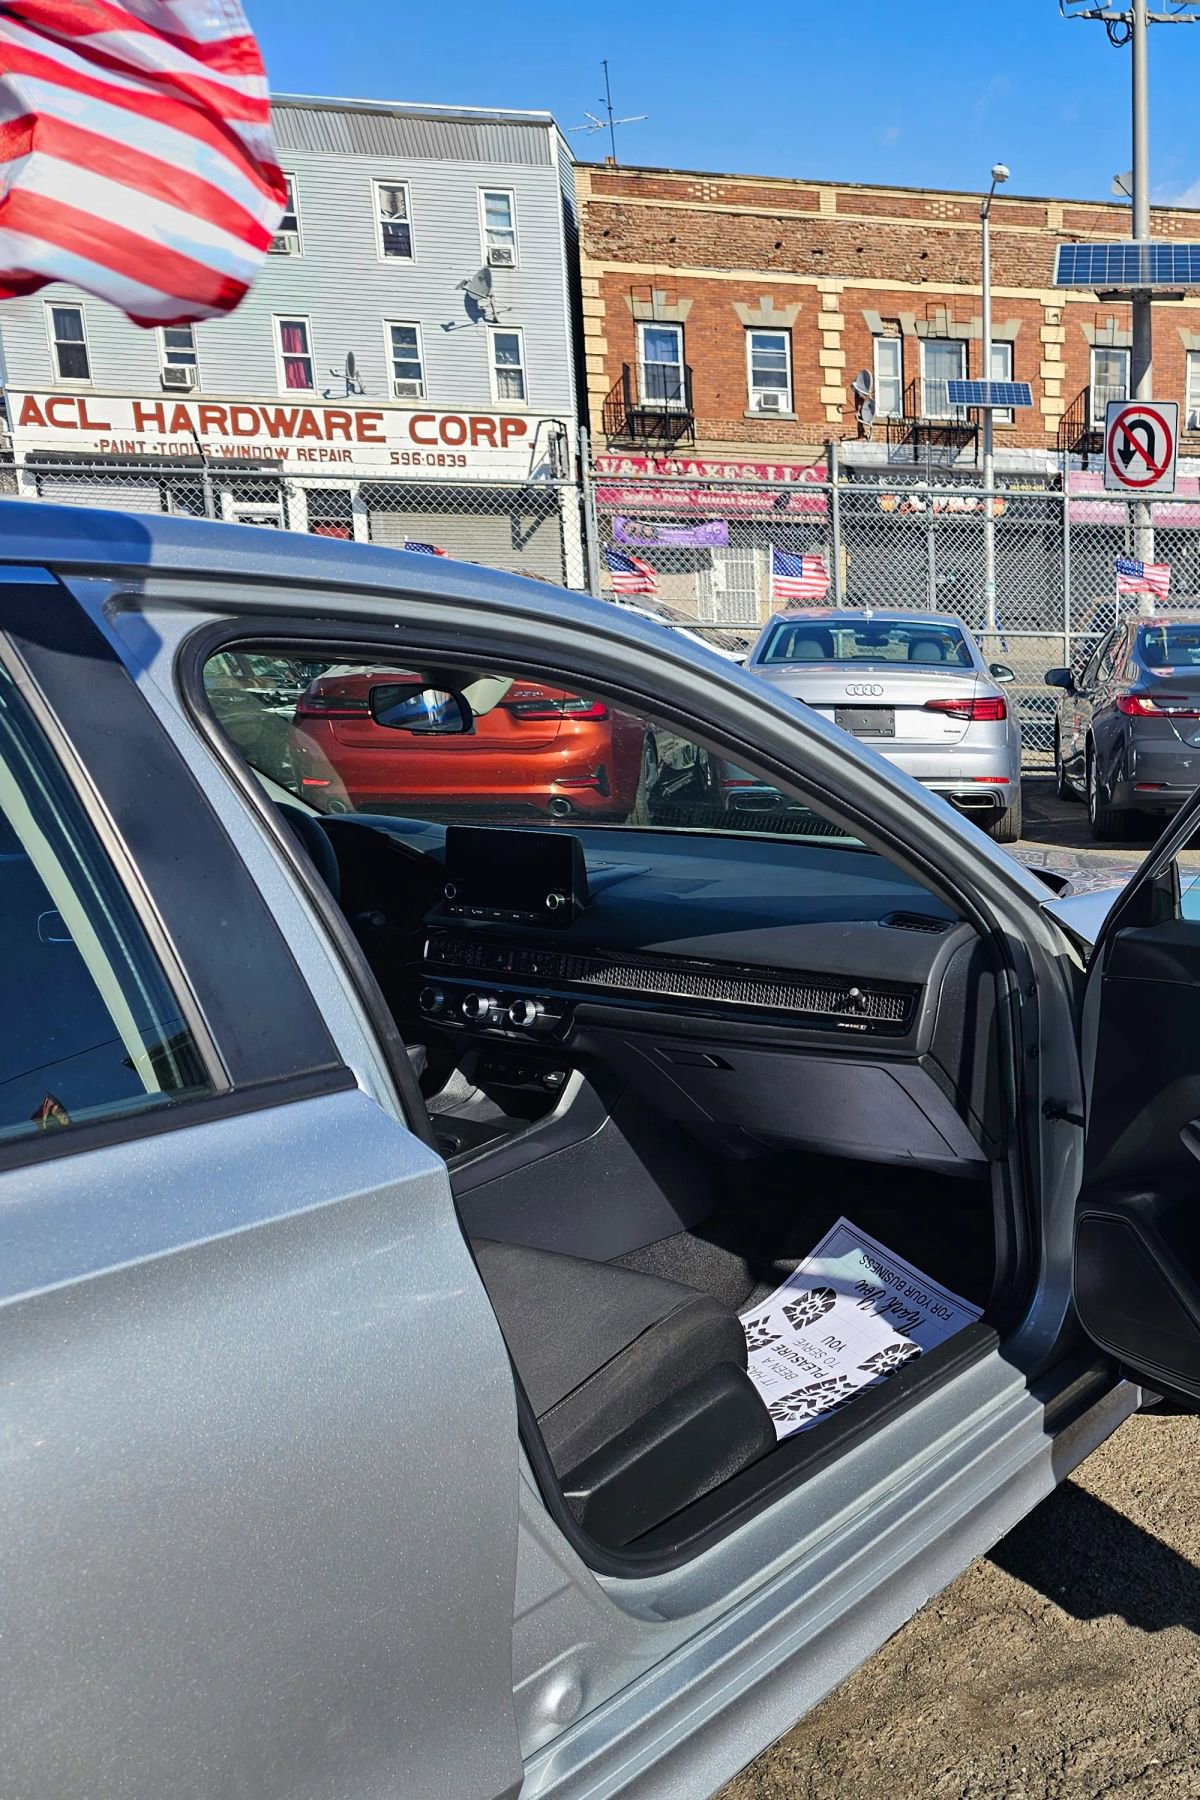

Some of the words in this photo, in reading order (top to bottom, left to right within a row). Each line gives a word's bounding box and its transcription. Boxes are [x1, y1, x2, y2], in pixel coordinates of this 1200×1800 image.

[19, 395, 111, 431] ACL
[132, 401, 387, 444] HARDWARE
[409, 414, 535, 449] CORP.
[297, 447, 353, 462] REPAIR
[859, 1254, 908, 1291] BUSINESS
[854, 1279, 887, 1311] You
[904, 1285, 933, 1309] YOUR
[870, 1296, 926, 1338] Thank
[930, 1303, 954, 1321] FOR
[793, 1338, 827, 1359] SERVE
[821, 1335, 847, 1352] YOU
[768, 1362, 799, 1380] BEEN
[771, 1343, 829, 1379] PLEASURE
[823, 1357, 841, 1369] TO
